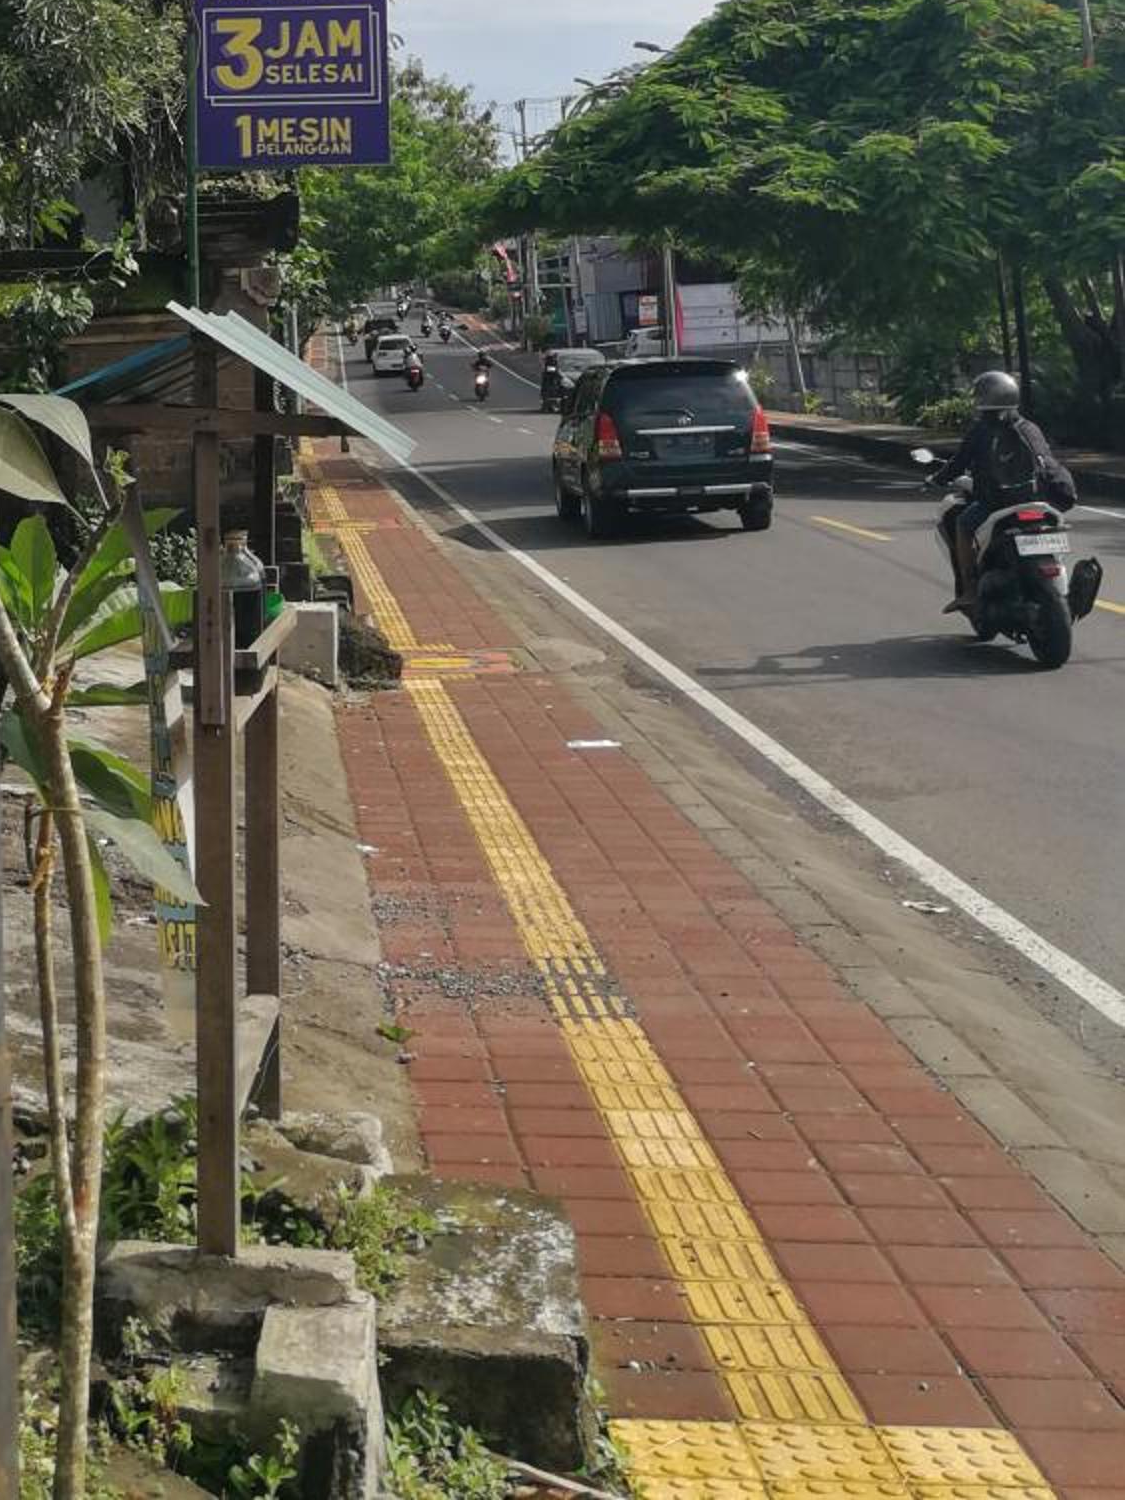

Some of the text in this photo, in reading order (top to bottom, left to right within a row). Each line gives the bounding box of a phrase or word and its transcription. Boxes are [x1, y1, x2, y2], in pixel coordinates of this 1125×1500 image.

[211, 17, 363, 91] 3 JAM
[265, 63, 364, 85] SELESAI
[235, 114, 352, 159] 1 MESIN
[255, 142, 352, 156] PELANGGAN
